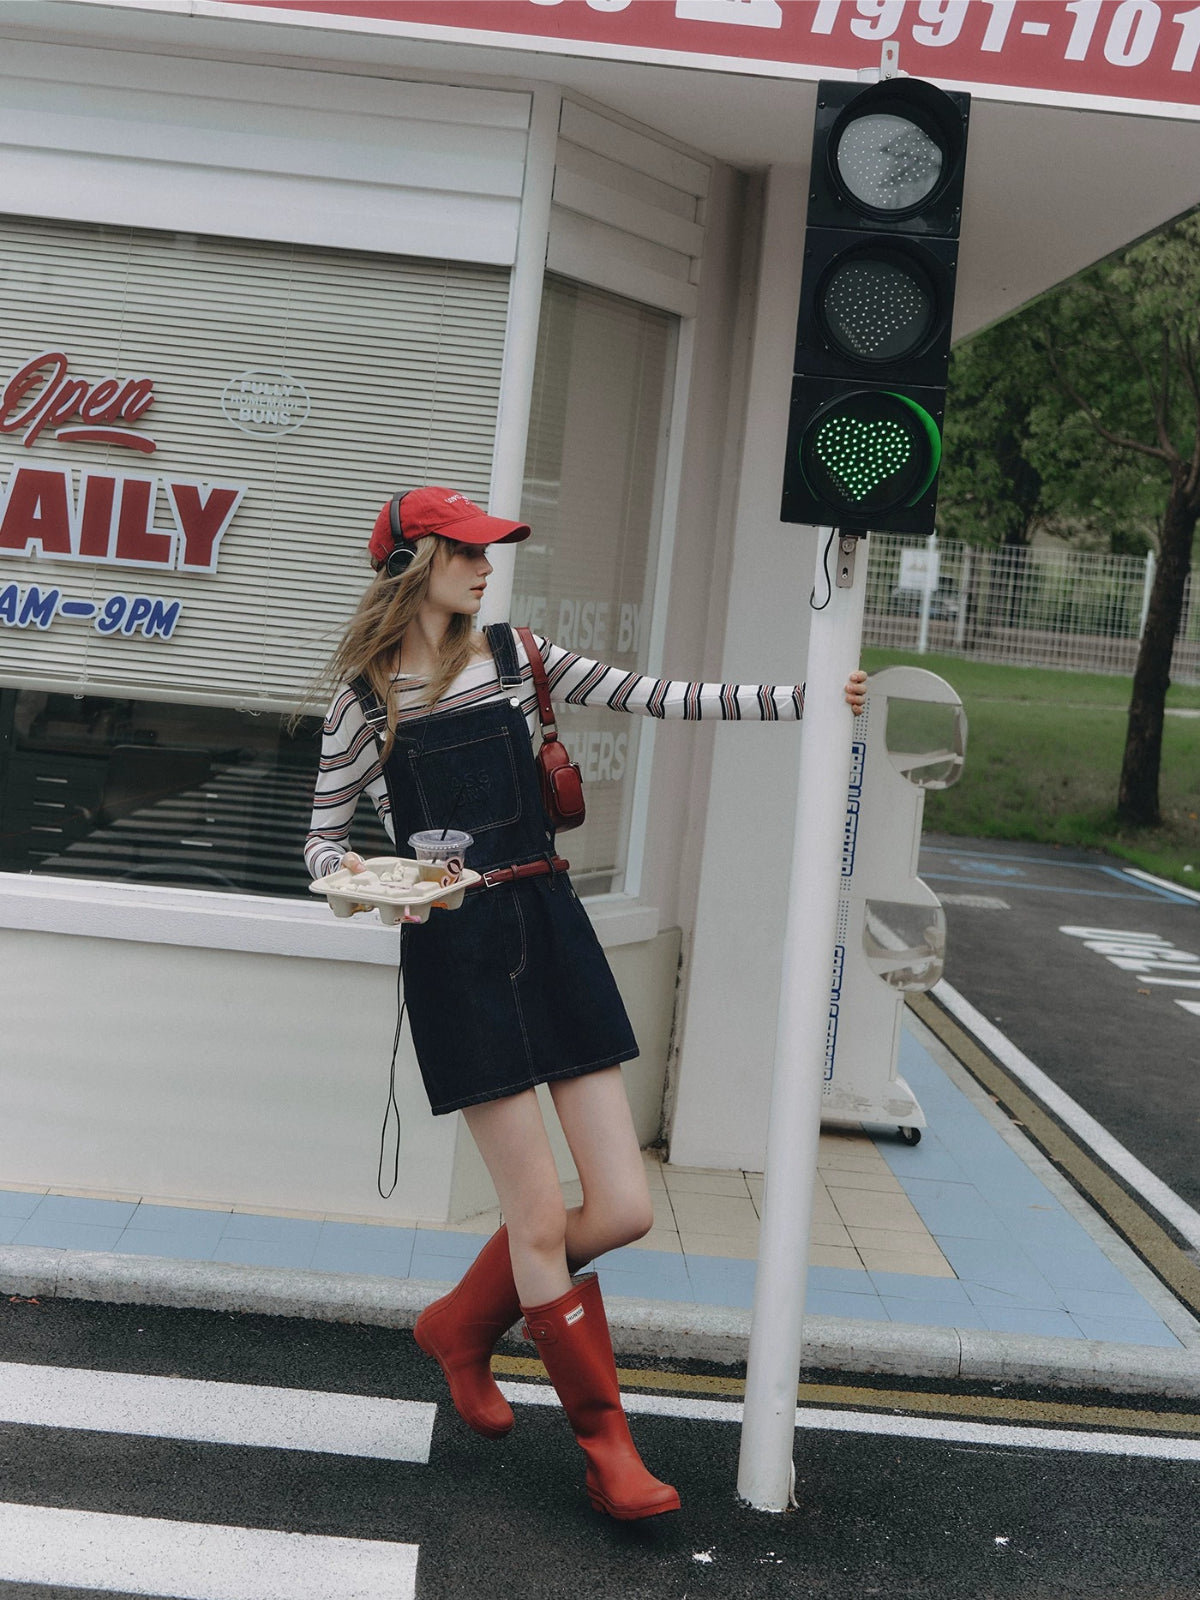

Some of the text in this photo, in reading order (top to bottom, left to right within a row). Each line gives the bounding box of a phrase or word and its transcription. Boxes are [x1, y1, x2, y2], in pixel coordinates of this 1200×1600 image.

[0, 350, 155, 448] Open
[240, 381, 293, 397] FULLY
[239, 407, 291, 425] BUNS
[557, 599, 609, 650] RISE
[560, 731, 628, 781] THERS
